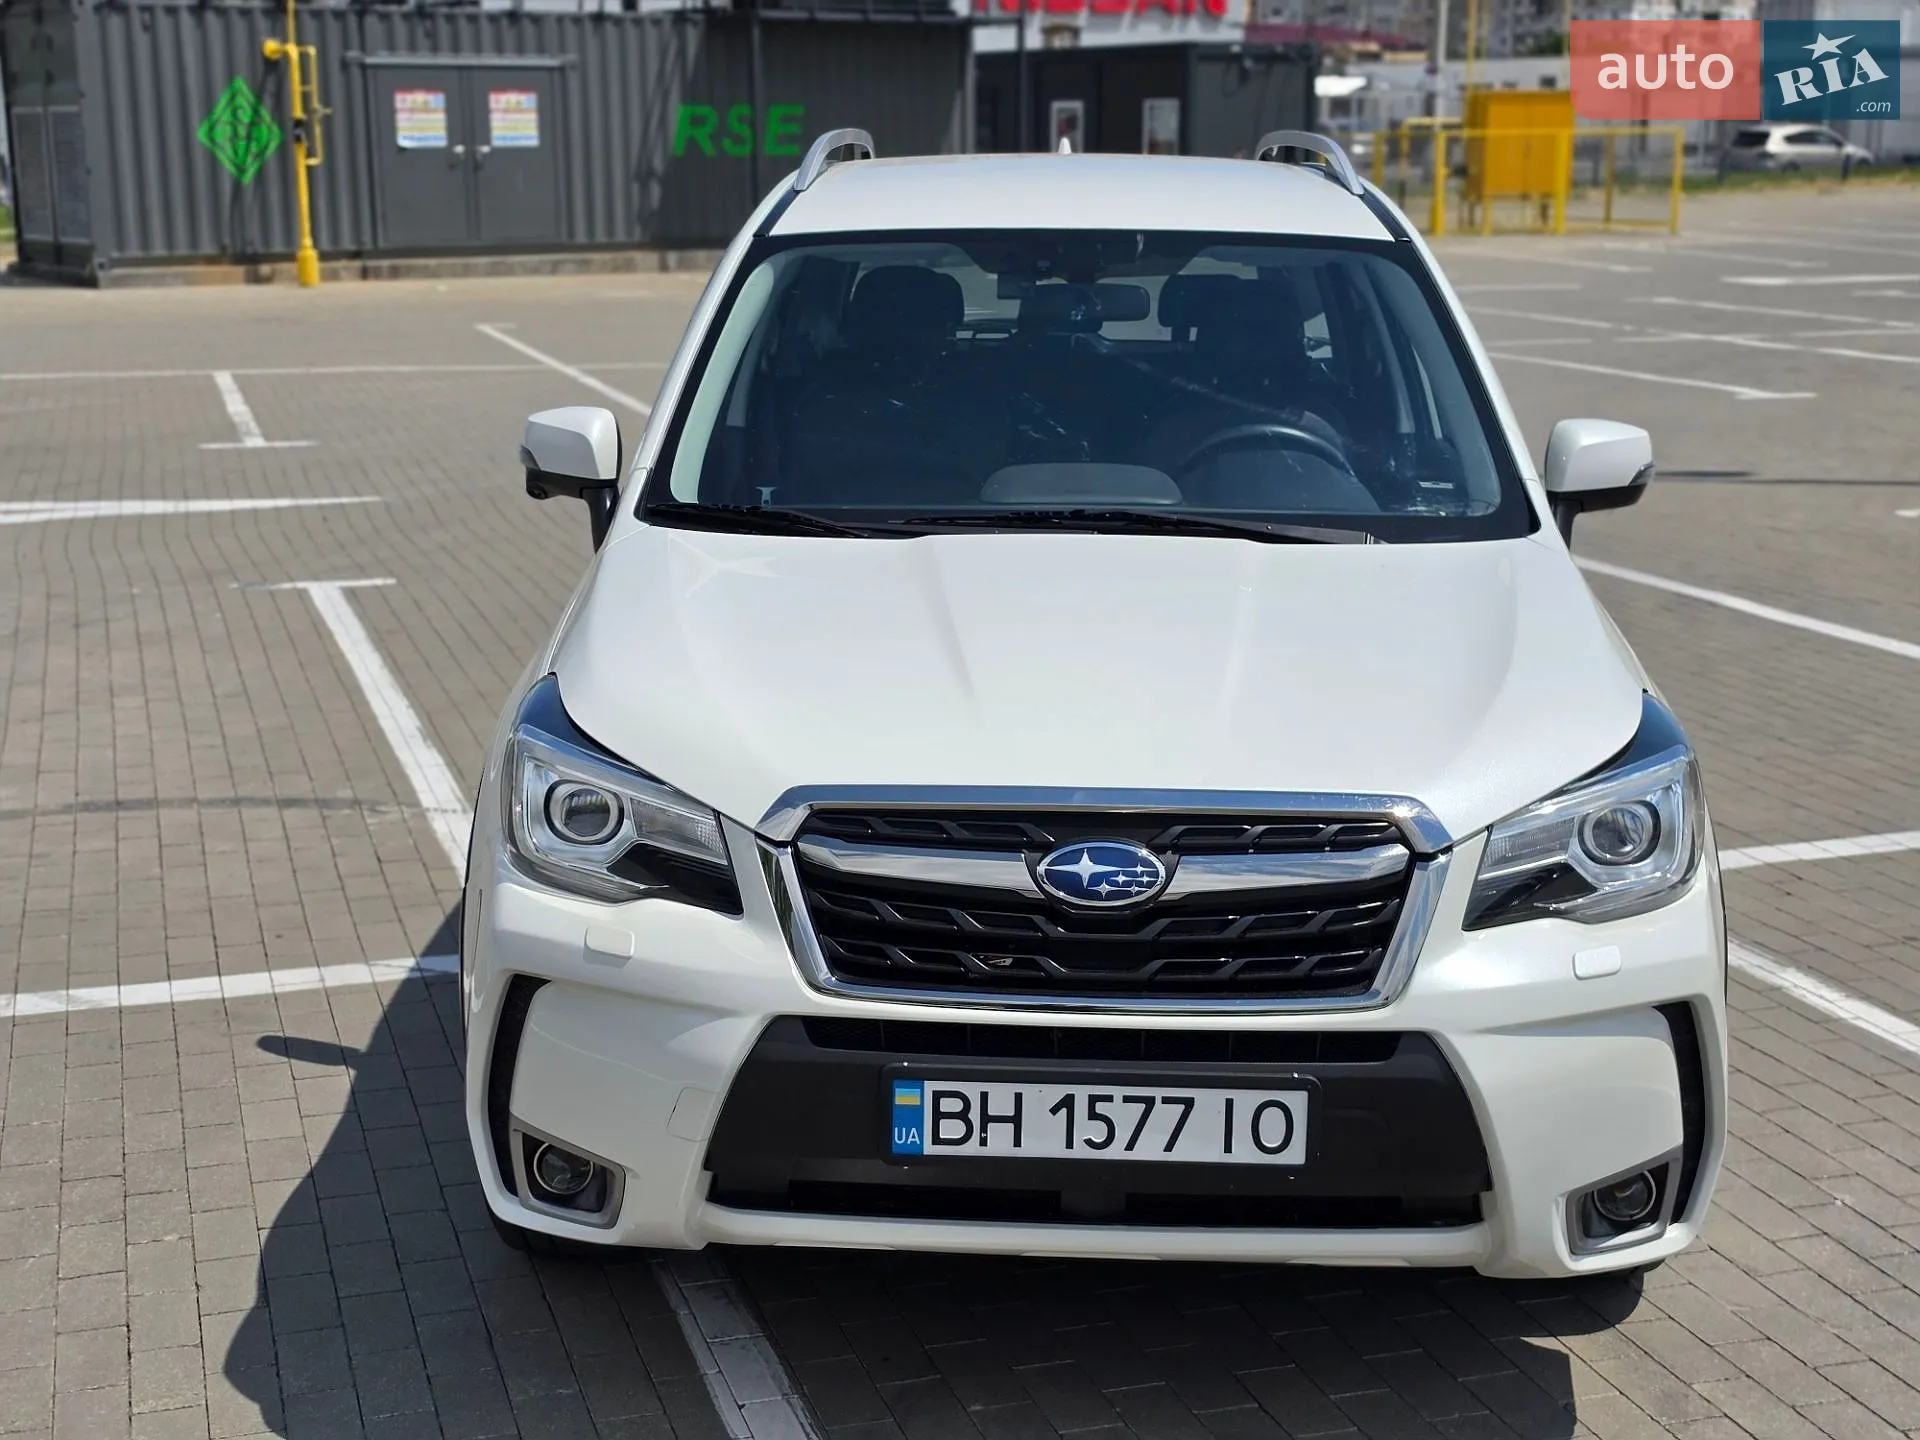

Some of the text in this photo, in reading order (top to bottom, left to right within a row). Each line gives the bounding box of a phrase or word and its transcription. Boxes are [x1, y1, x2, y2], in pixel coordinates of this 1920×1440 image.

[673, 104, 805, 157] RSE
[893, 1127, 921, 1144] UA
[930, 1089, 1295, 1154] BH 1577 IO
